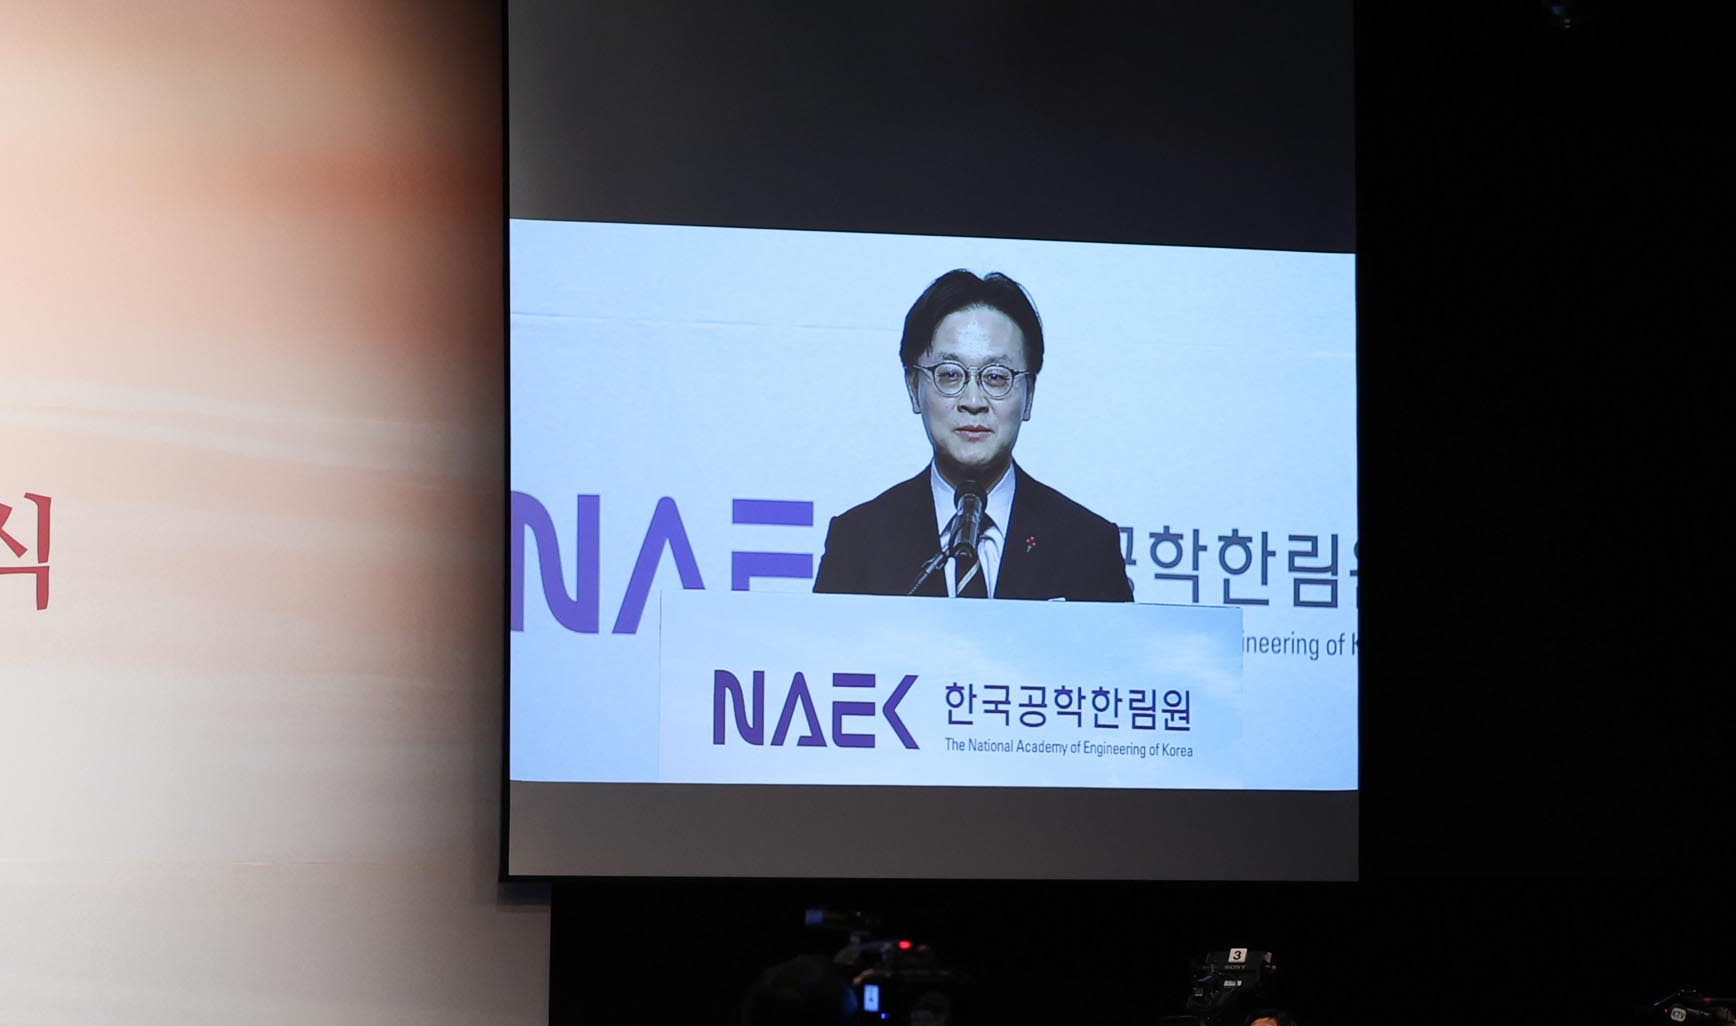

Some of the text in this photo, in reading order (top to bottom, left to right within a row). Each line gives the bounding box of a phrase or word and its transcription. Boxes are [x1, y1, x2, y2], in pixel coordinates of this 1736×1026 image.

[511, 490, 815, 635] NAE
[1326, 634, 1345, 656] of
[712, 669, 921, 750] NAEK
[945, 682, 1191, 731] 한국공학한림원
[945, 737, 1194, 759] The National Academy of Engineering of Korea
[1233, 950, 1242, 960] 3
